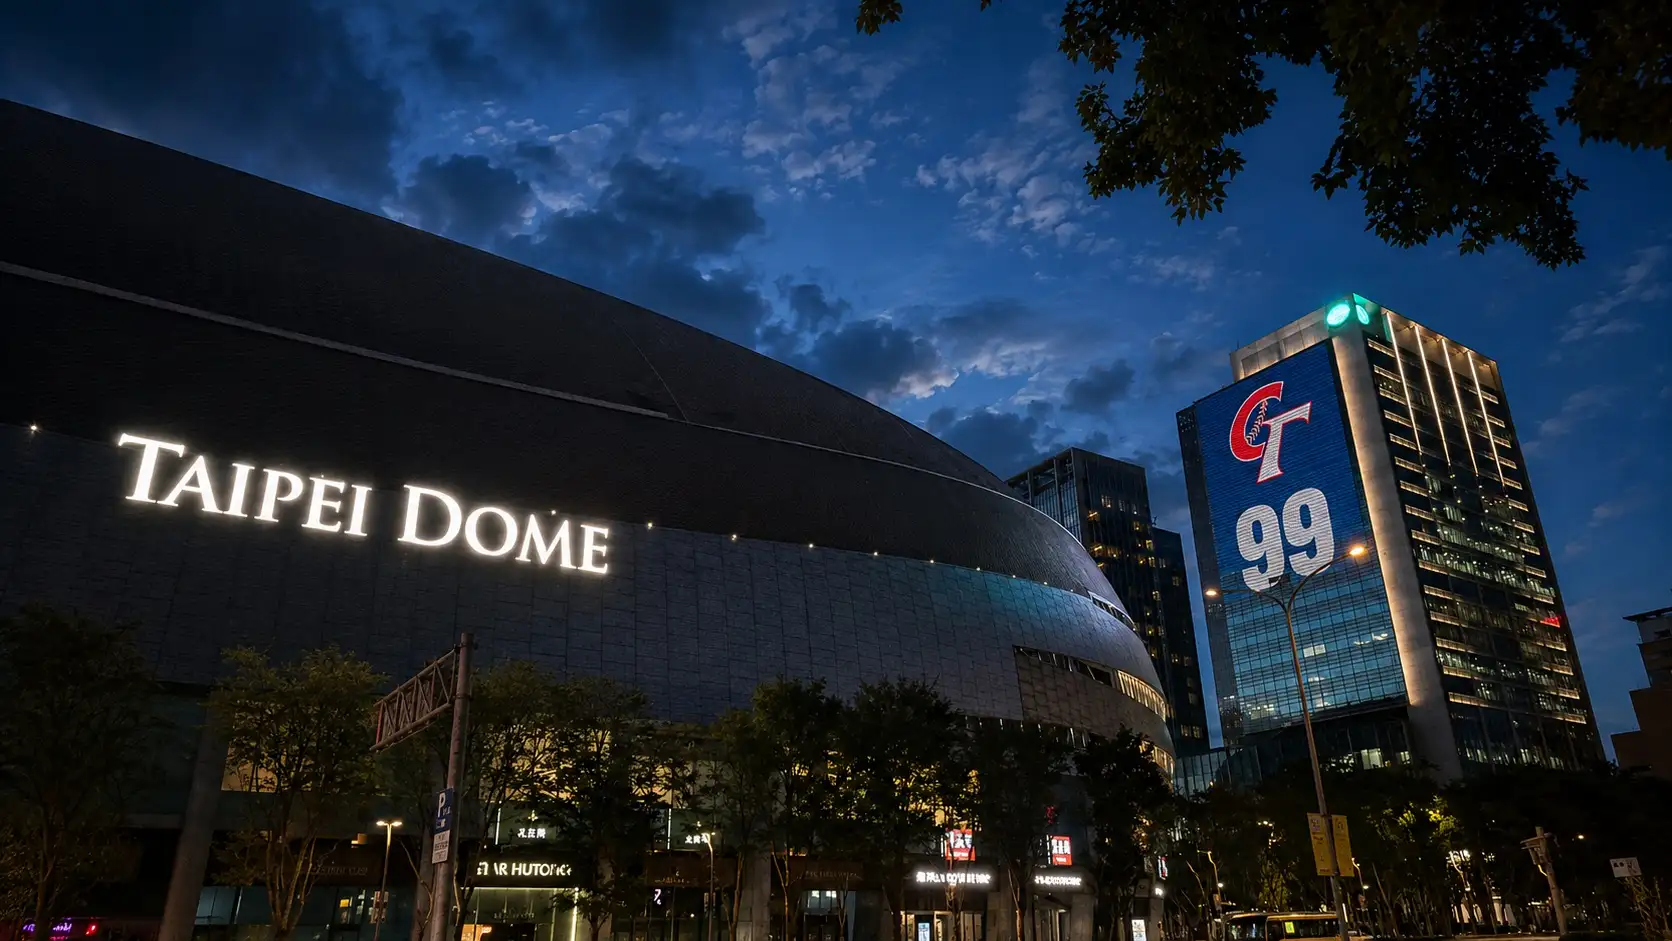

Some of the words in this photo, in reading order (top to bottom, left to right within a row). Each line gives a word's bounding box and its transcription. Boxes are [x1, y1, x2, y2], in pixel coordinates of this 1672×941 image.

[1229, 381, 1312, 483] CT
[118, 433, 373, 537] TAIPEI
[398, 484, 610, 574] DOME
[1236, 487, 1335, 592] 99
